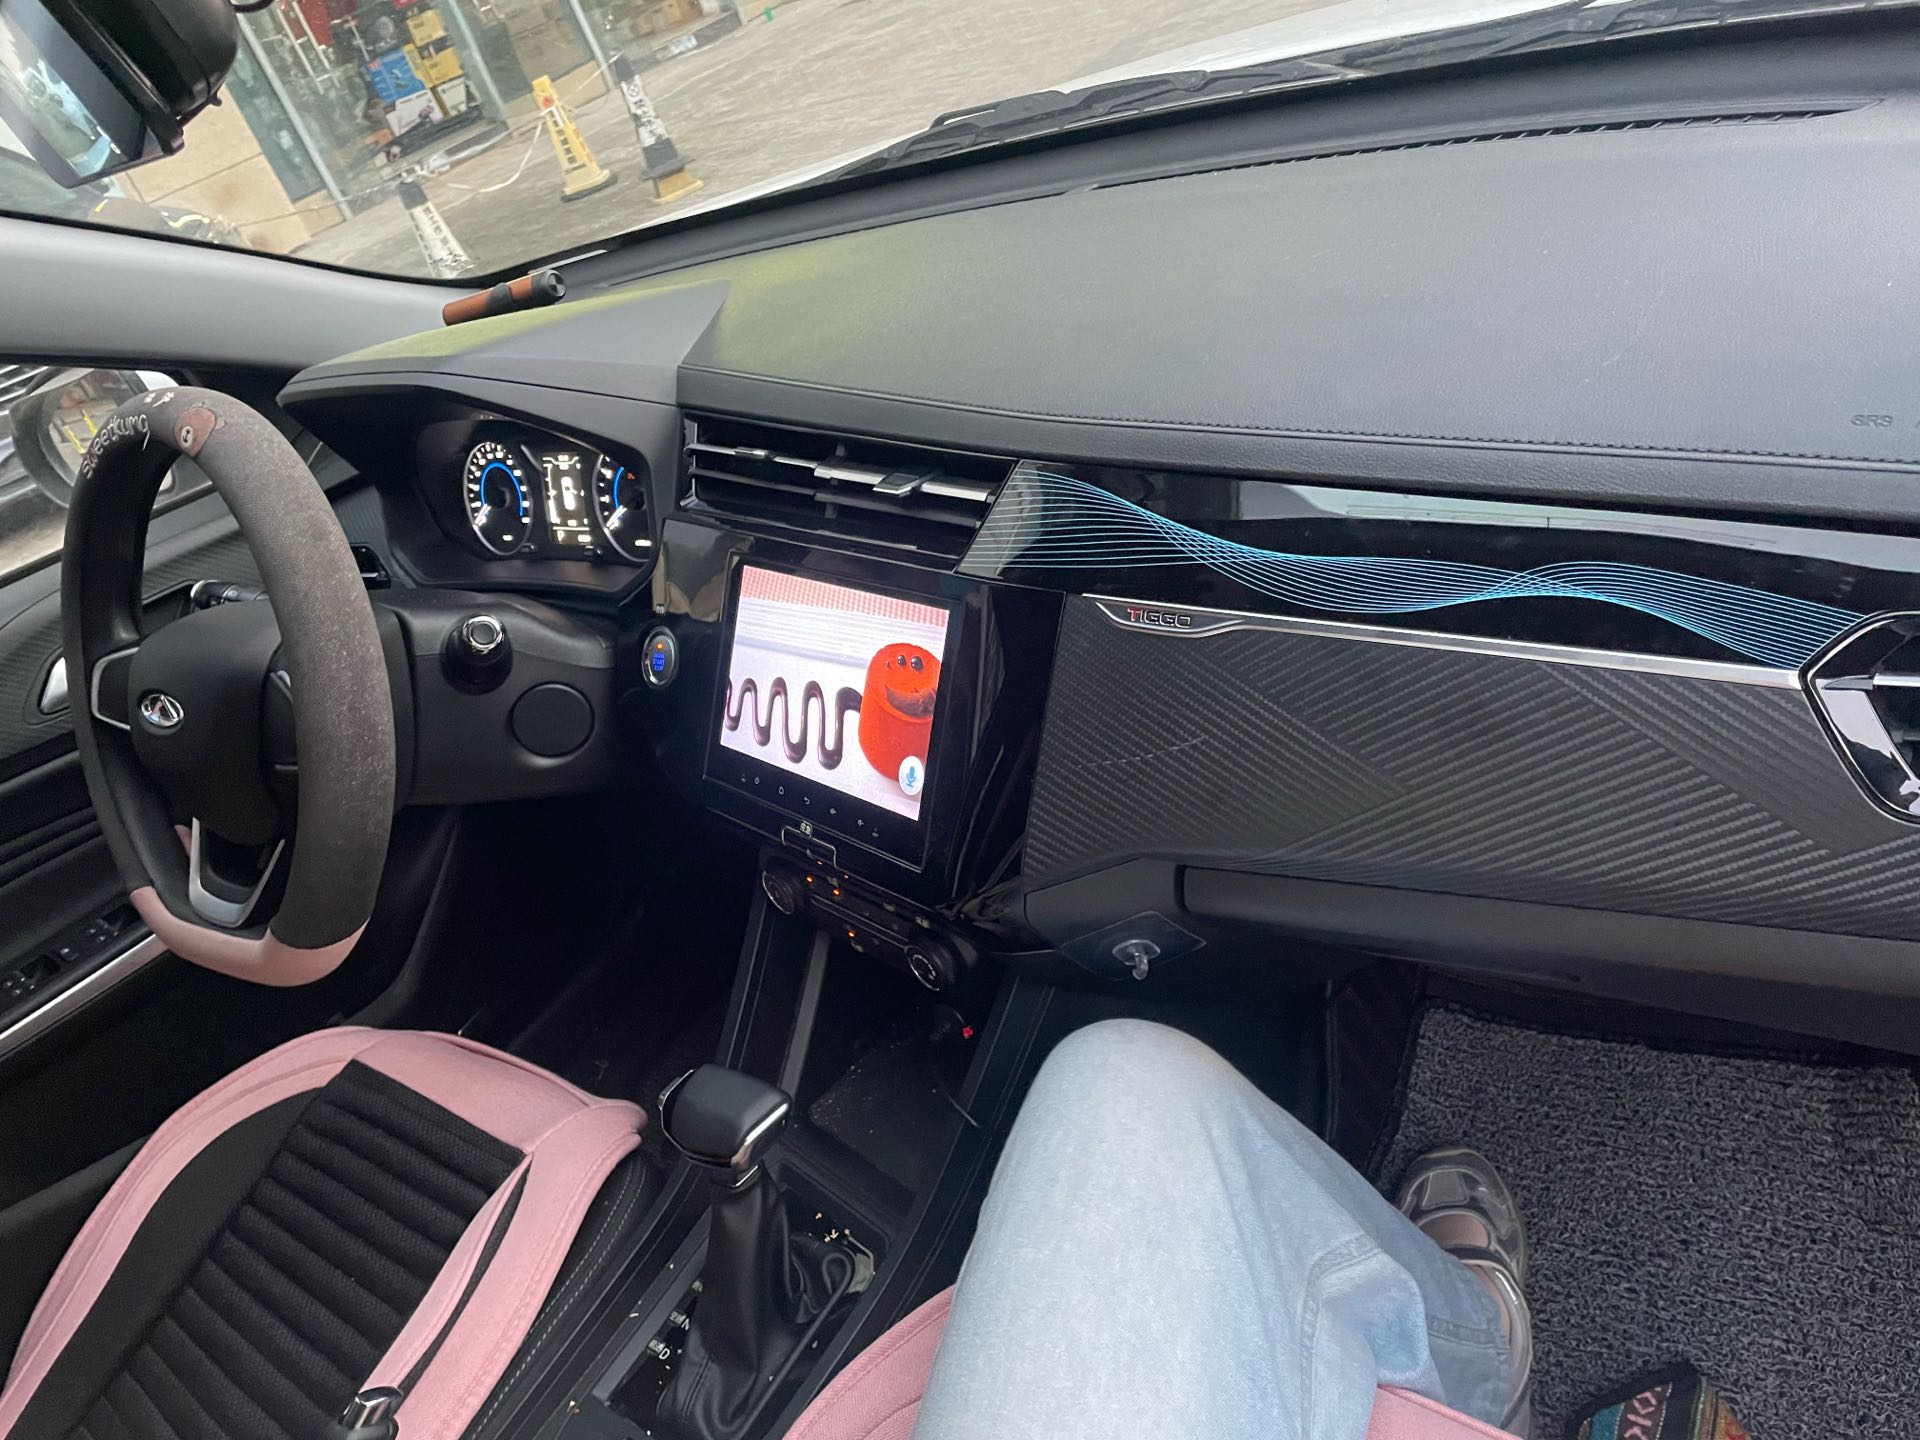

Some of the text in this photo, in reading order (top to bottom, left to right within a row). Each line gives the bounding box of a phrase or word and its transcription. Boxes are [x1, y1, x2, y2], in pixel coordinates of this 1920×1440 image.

[1851, 414, 1893, 427] SRS
[1127, 607, 1191, 629] TIGGO
[658, 1347, 671, 1360] D
